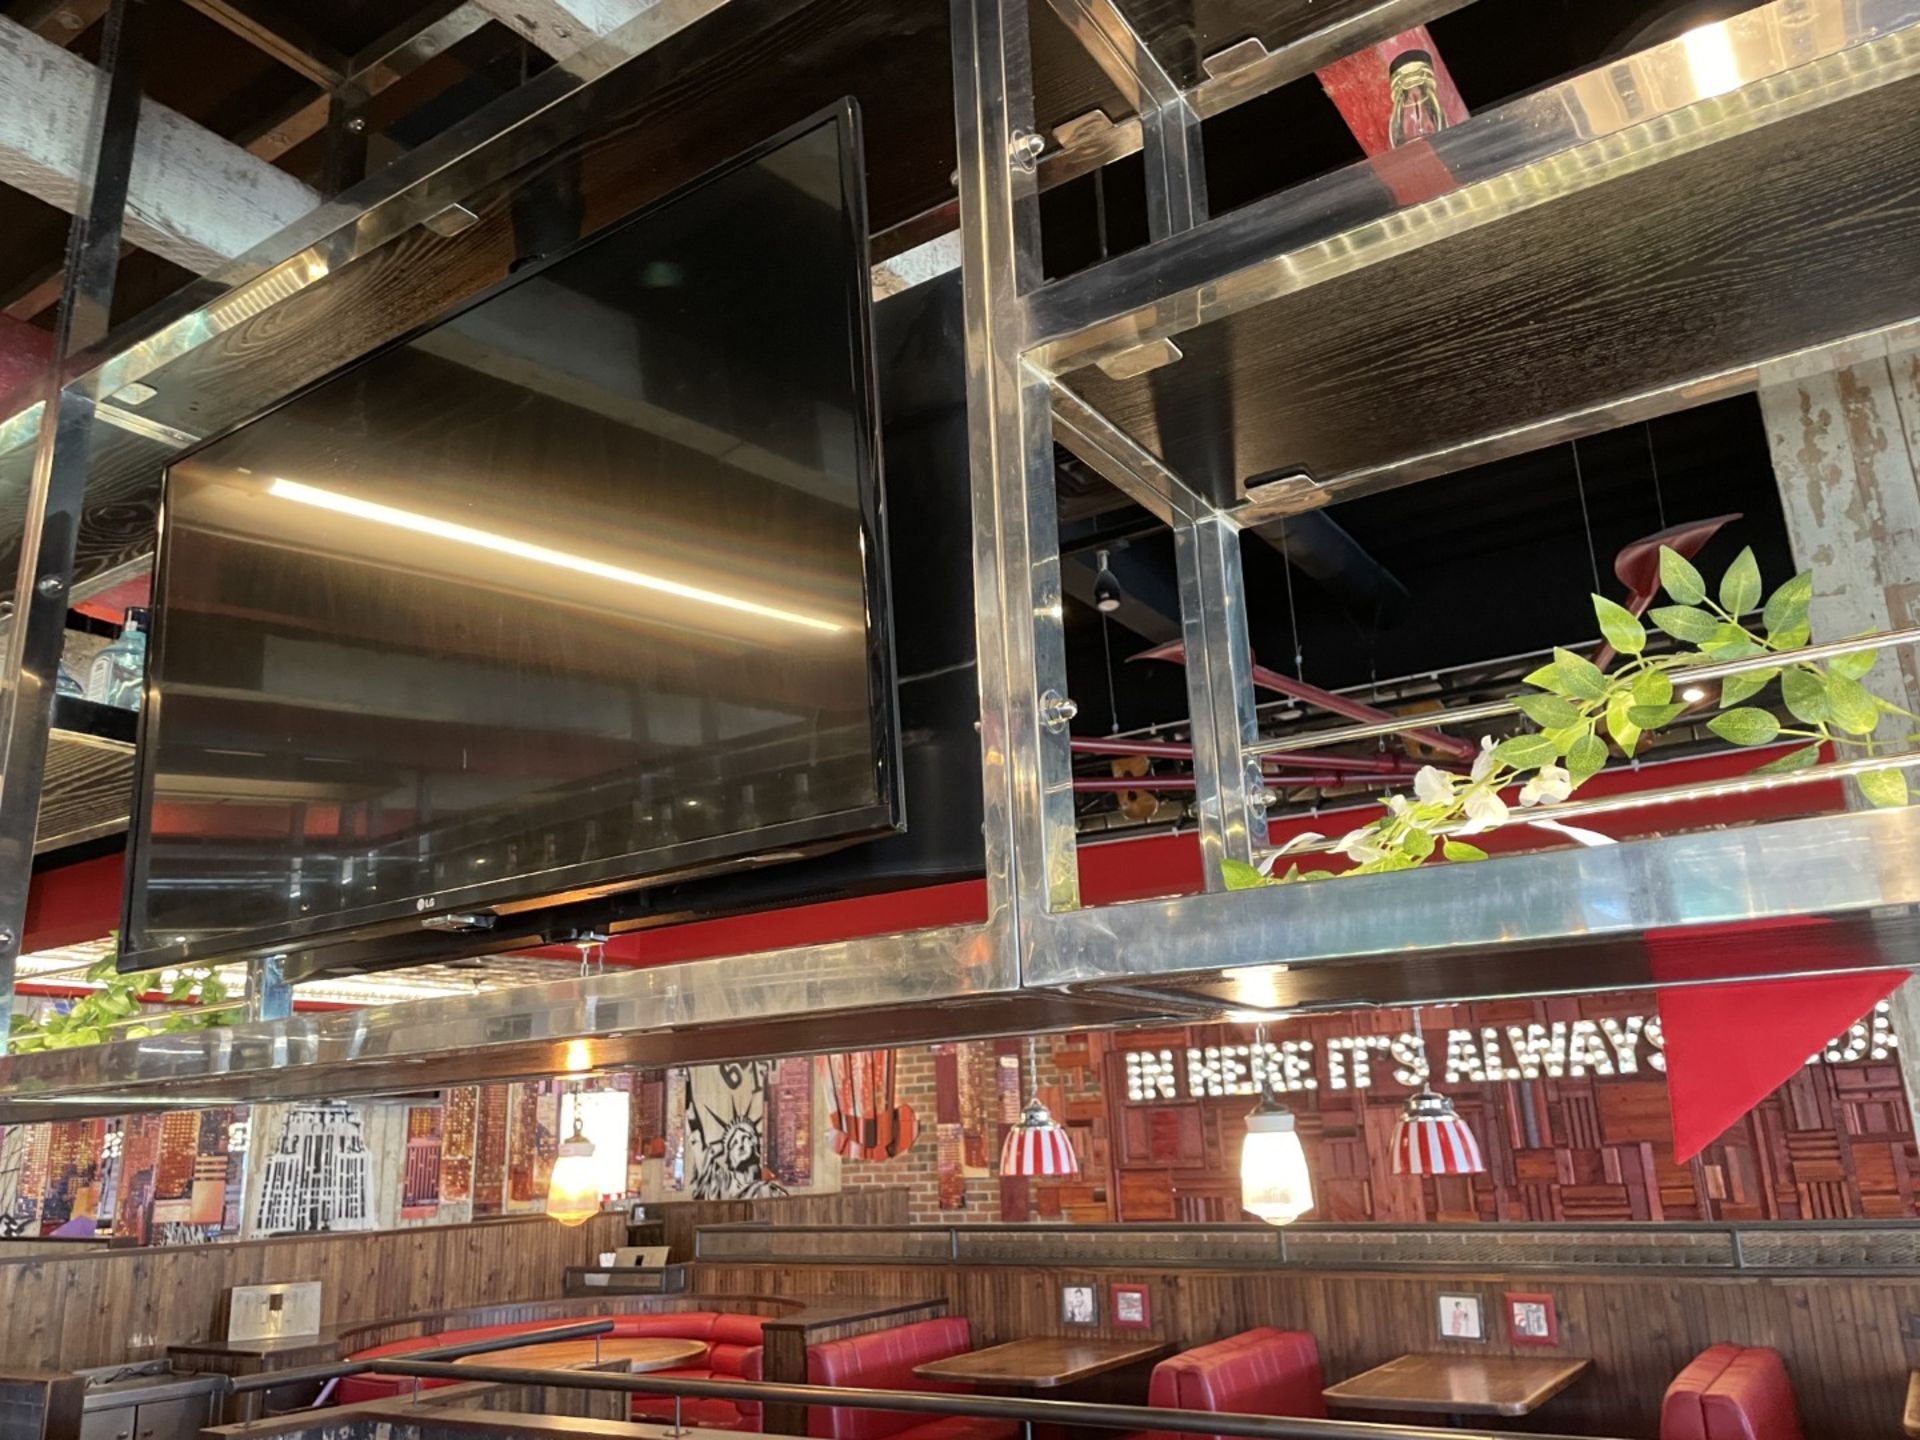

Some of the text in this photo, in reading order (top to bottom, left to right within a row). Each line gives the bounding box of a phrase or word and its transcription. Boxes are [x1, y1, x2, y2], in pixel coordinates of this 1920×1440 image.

[1126, 1050, 1176, 1101] IN
[1187, 1041, 1318, 1097] HERE
[1327, 1032, 1430, 1089] IT'S
